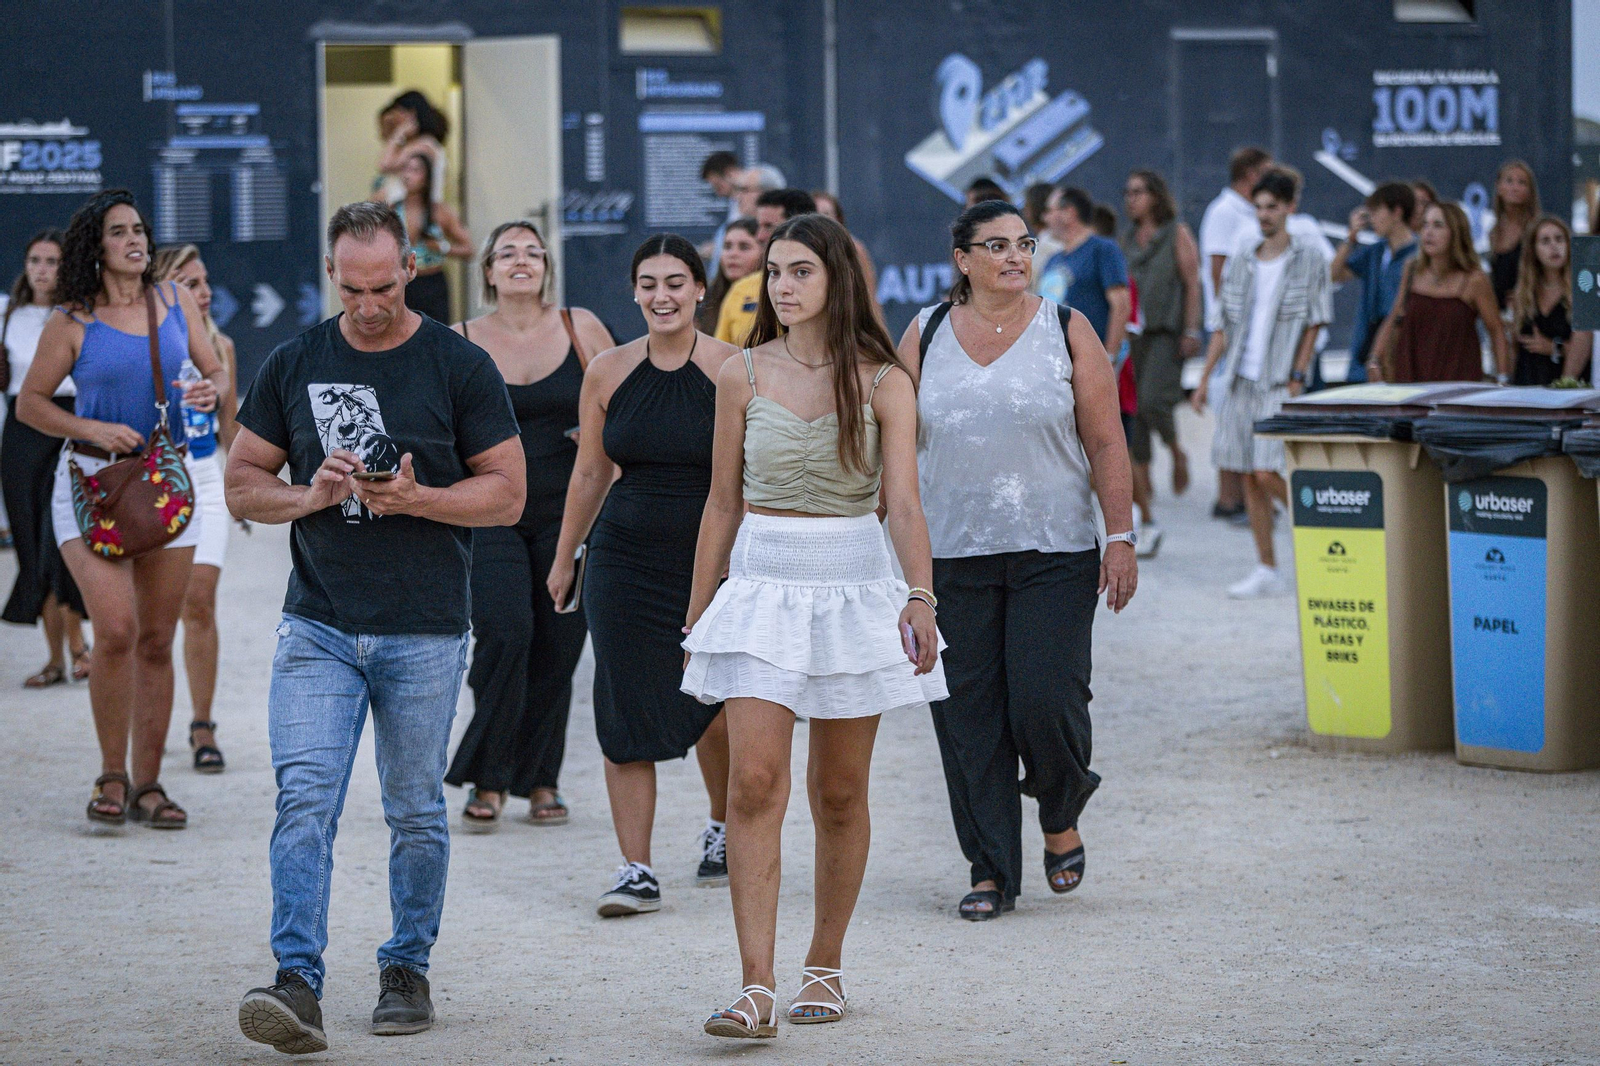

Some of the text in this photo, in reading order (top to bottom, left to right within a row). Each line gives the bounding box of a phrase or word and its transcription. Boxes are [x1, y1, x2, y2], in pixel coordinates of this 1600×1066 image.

[1372, 85, 1498, 132] 100M
[1315, 486, 1371, 506] urbaser
[1475, 491, 1534, 513] urbaser
[1308, 598, 1375, 613] ENVASES DE
[1473, 616, 1519, 635] PAPEL
[1320, 633, 1364, 647] LATAS Y
[1326, 650, 1359, 664] BRIKS
